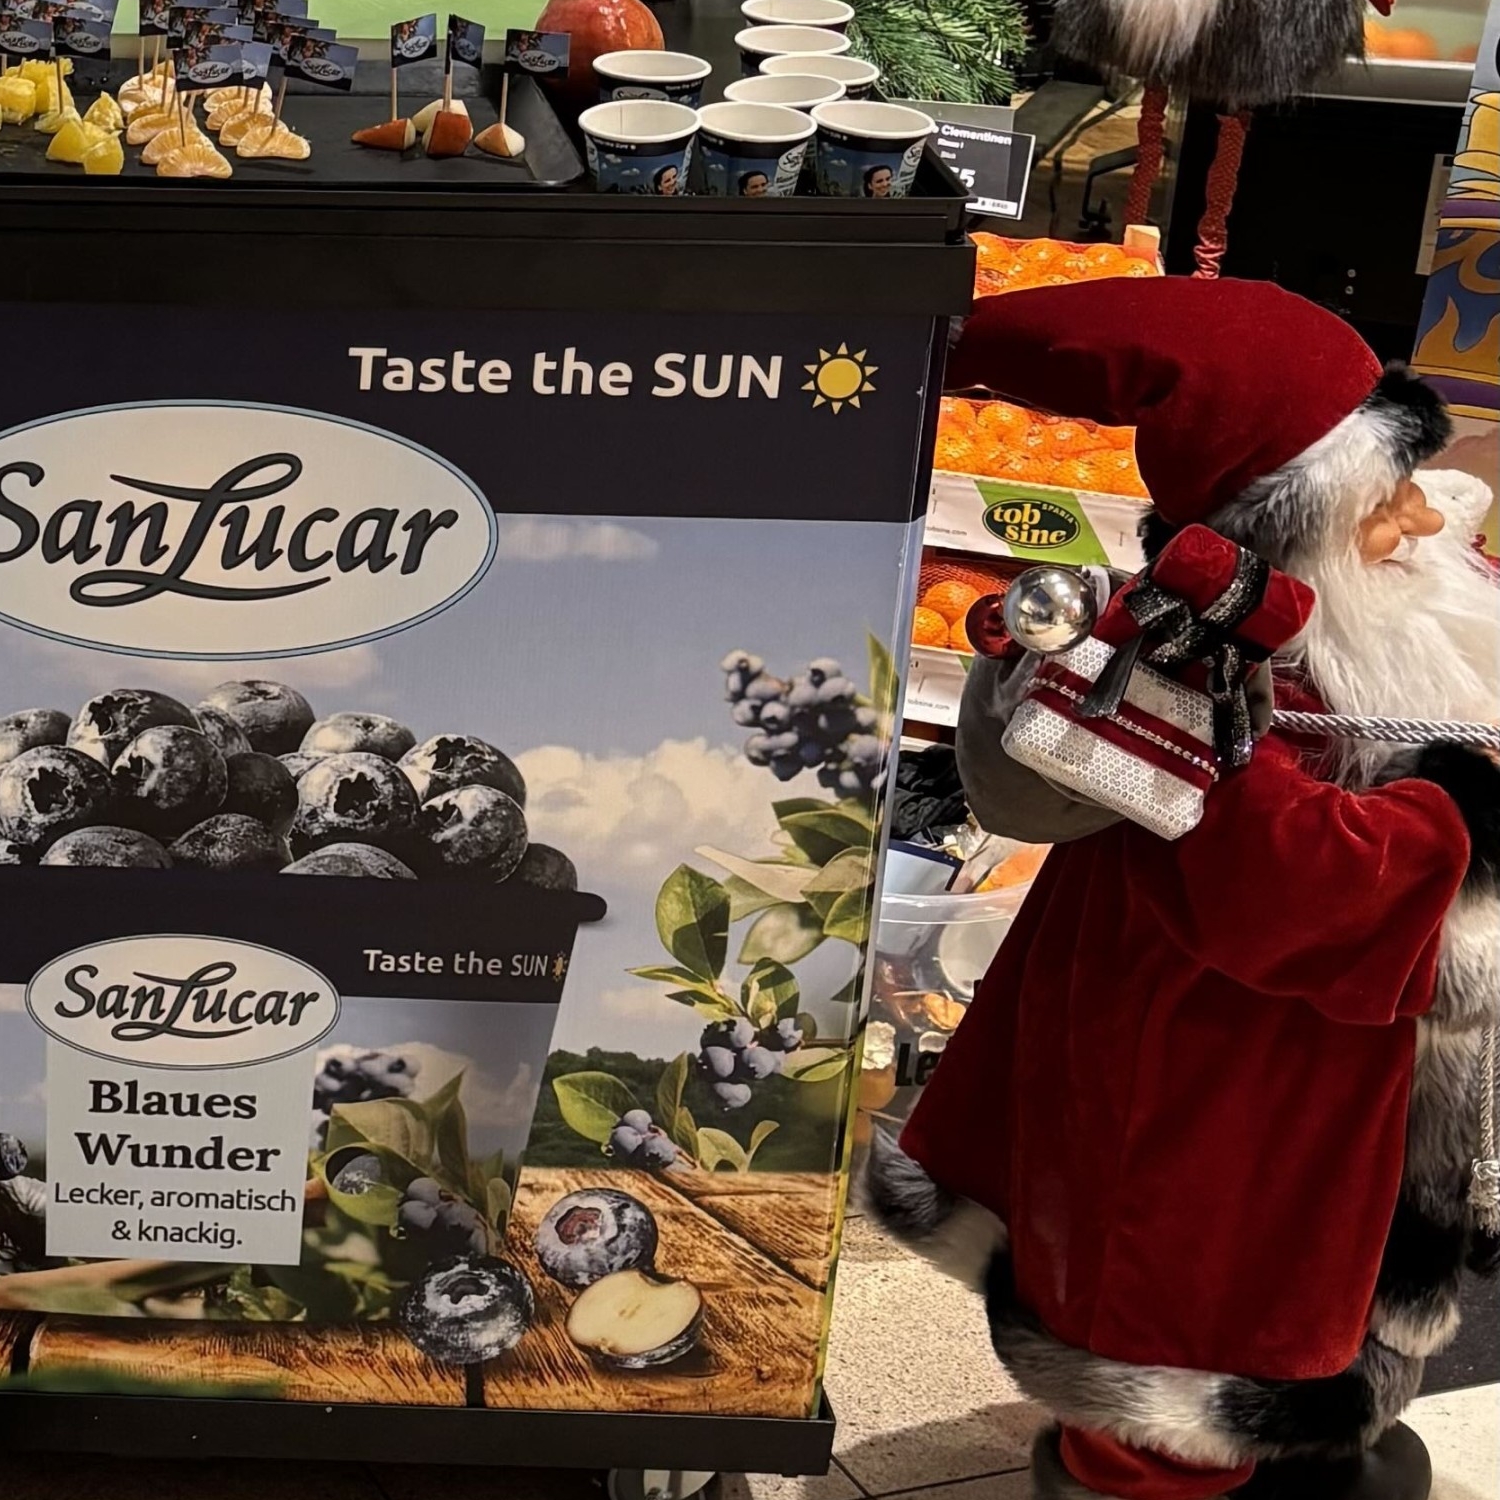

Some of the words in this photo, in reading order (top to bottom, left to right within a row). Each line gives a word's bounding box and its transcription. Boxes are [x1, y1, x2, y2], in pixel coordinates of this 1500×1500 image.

[1, 33, 37, 48] SanLucar
[941, 125, 1012, 146] Clementinen
[348, 346, 511, 394] Taste
[532, 348, 632, 396] the
[652, 352, 782, 399] SUN
[993, 503, 1041, 525] tob
[1005, 525, 1067, 545] sine
[363, 948, 444, 976] Taste
[453, 950, 503, 977] the
[510, 953, 547, 977] SUN
[54, 961, 319, 1041] SanLucar
[88, 1079, 257, 1120] Blaues
[75, 1132, 281, 1173] Wunder
[54, 1182, 145, 1211] Lecker,
[151, 1187, 296, 1213] aromatisch
[111, 1220, 131, 1241] &
[137, 1220, 243, 1248] knackig.
